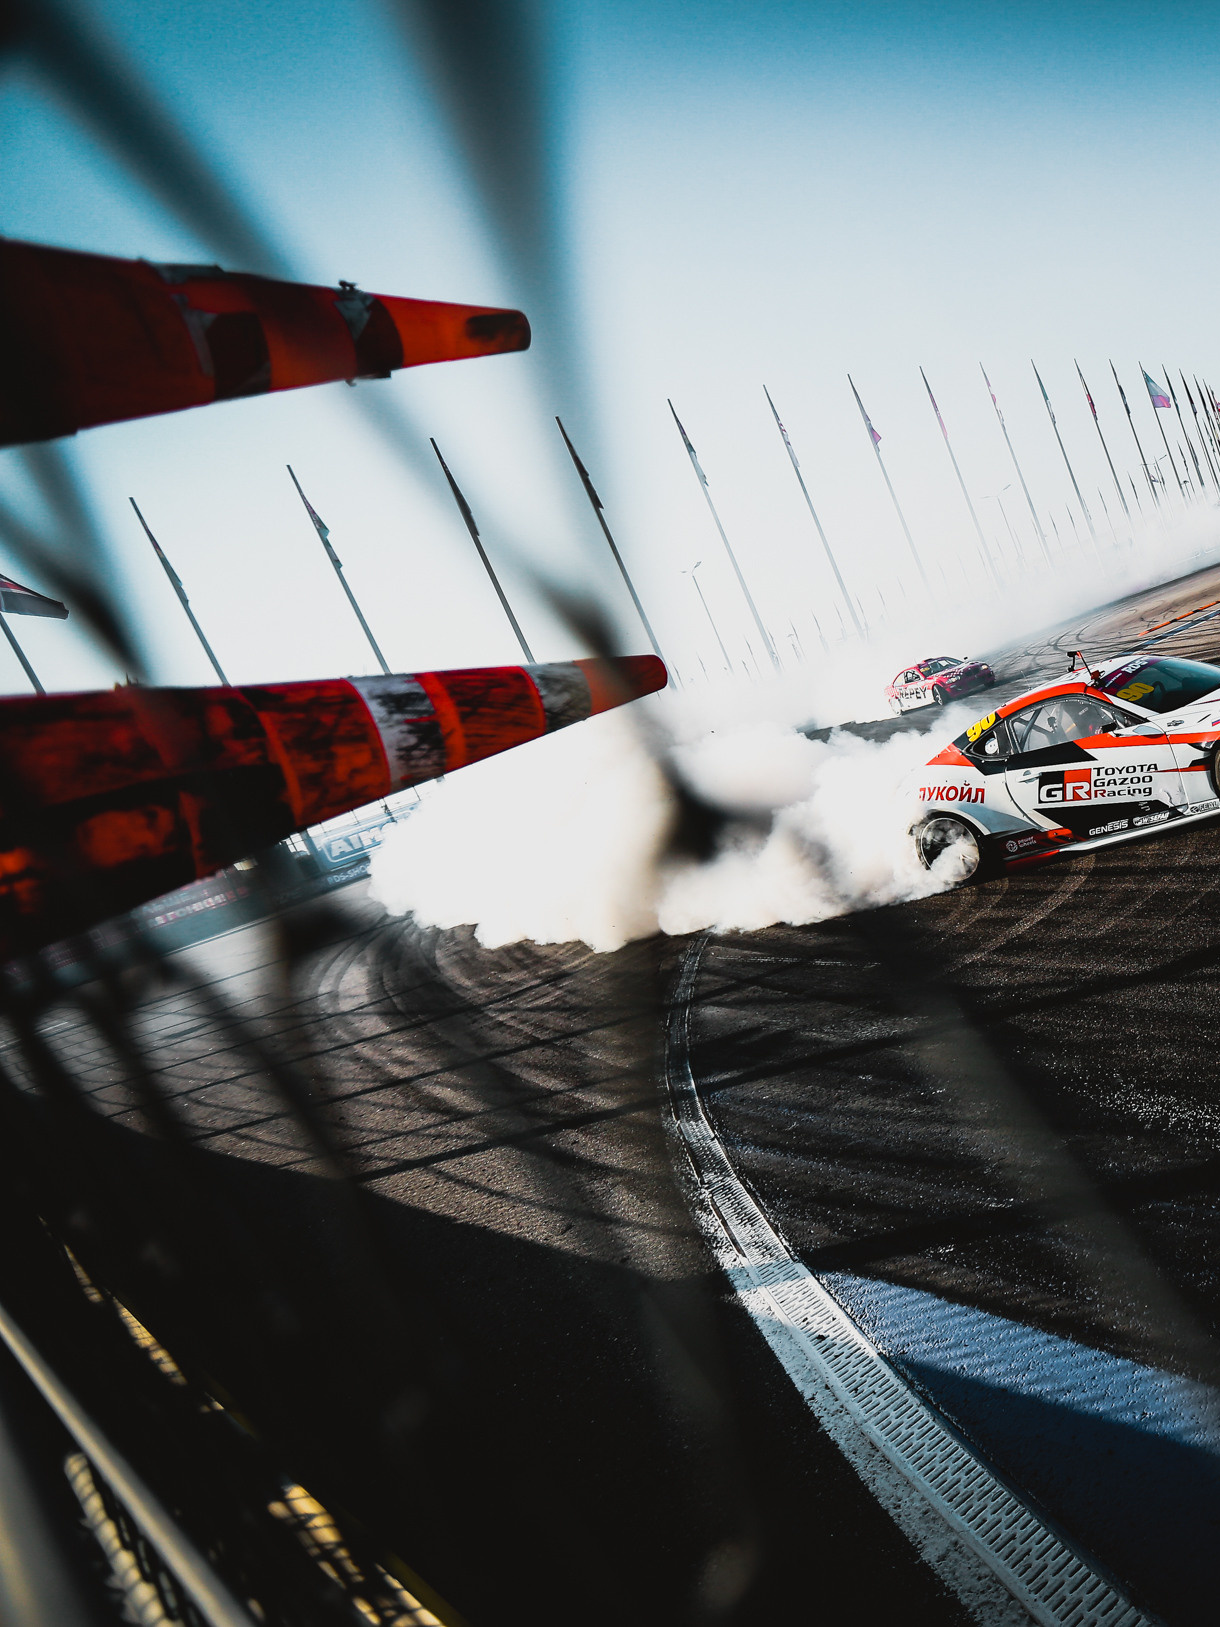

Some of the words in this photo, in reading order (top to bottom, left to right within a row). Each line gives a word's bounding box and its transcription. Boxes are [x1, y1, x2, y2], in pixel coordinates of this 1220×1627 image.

[1116, 682, 1155, 702] 90
[966, 712, 996, 742] 90
[1093, 775, 1153, 788] GAZOO
[919, 782, 985, 804] ЛУКОЙЛ
[1039, 782, 1091, 803] GR
[1094, 786, 1153, 799] Racing
[1089, 821, 1129, 836] GENESIS
[327, 862, 370, 885] RDS-SHO
